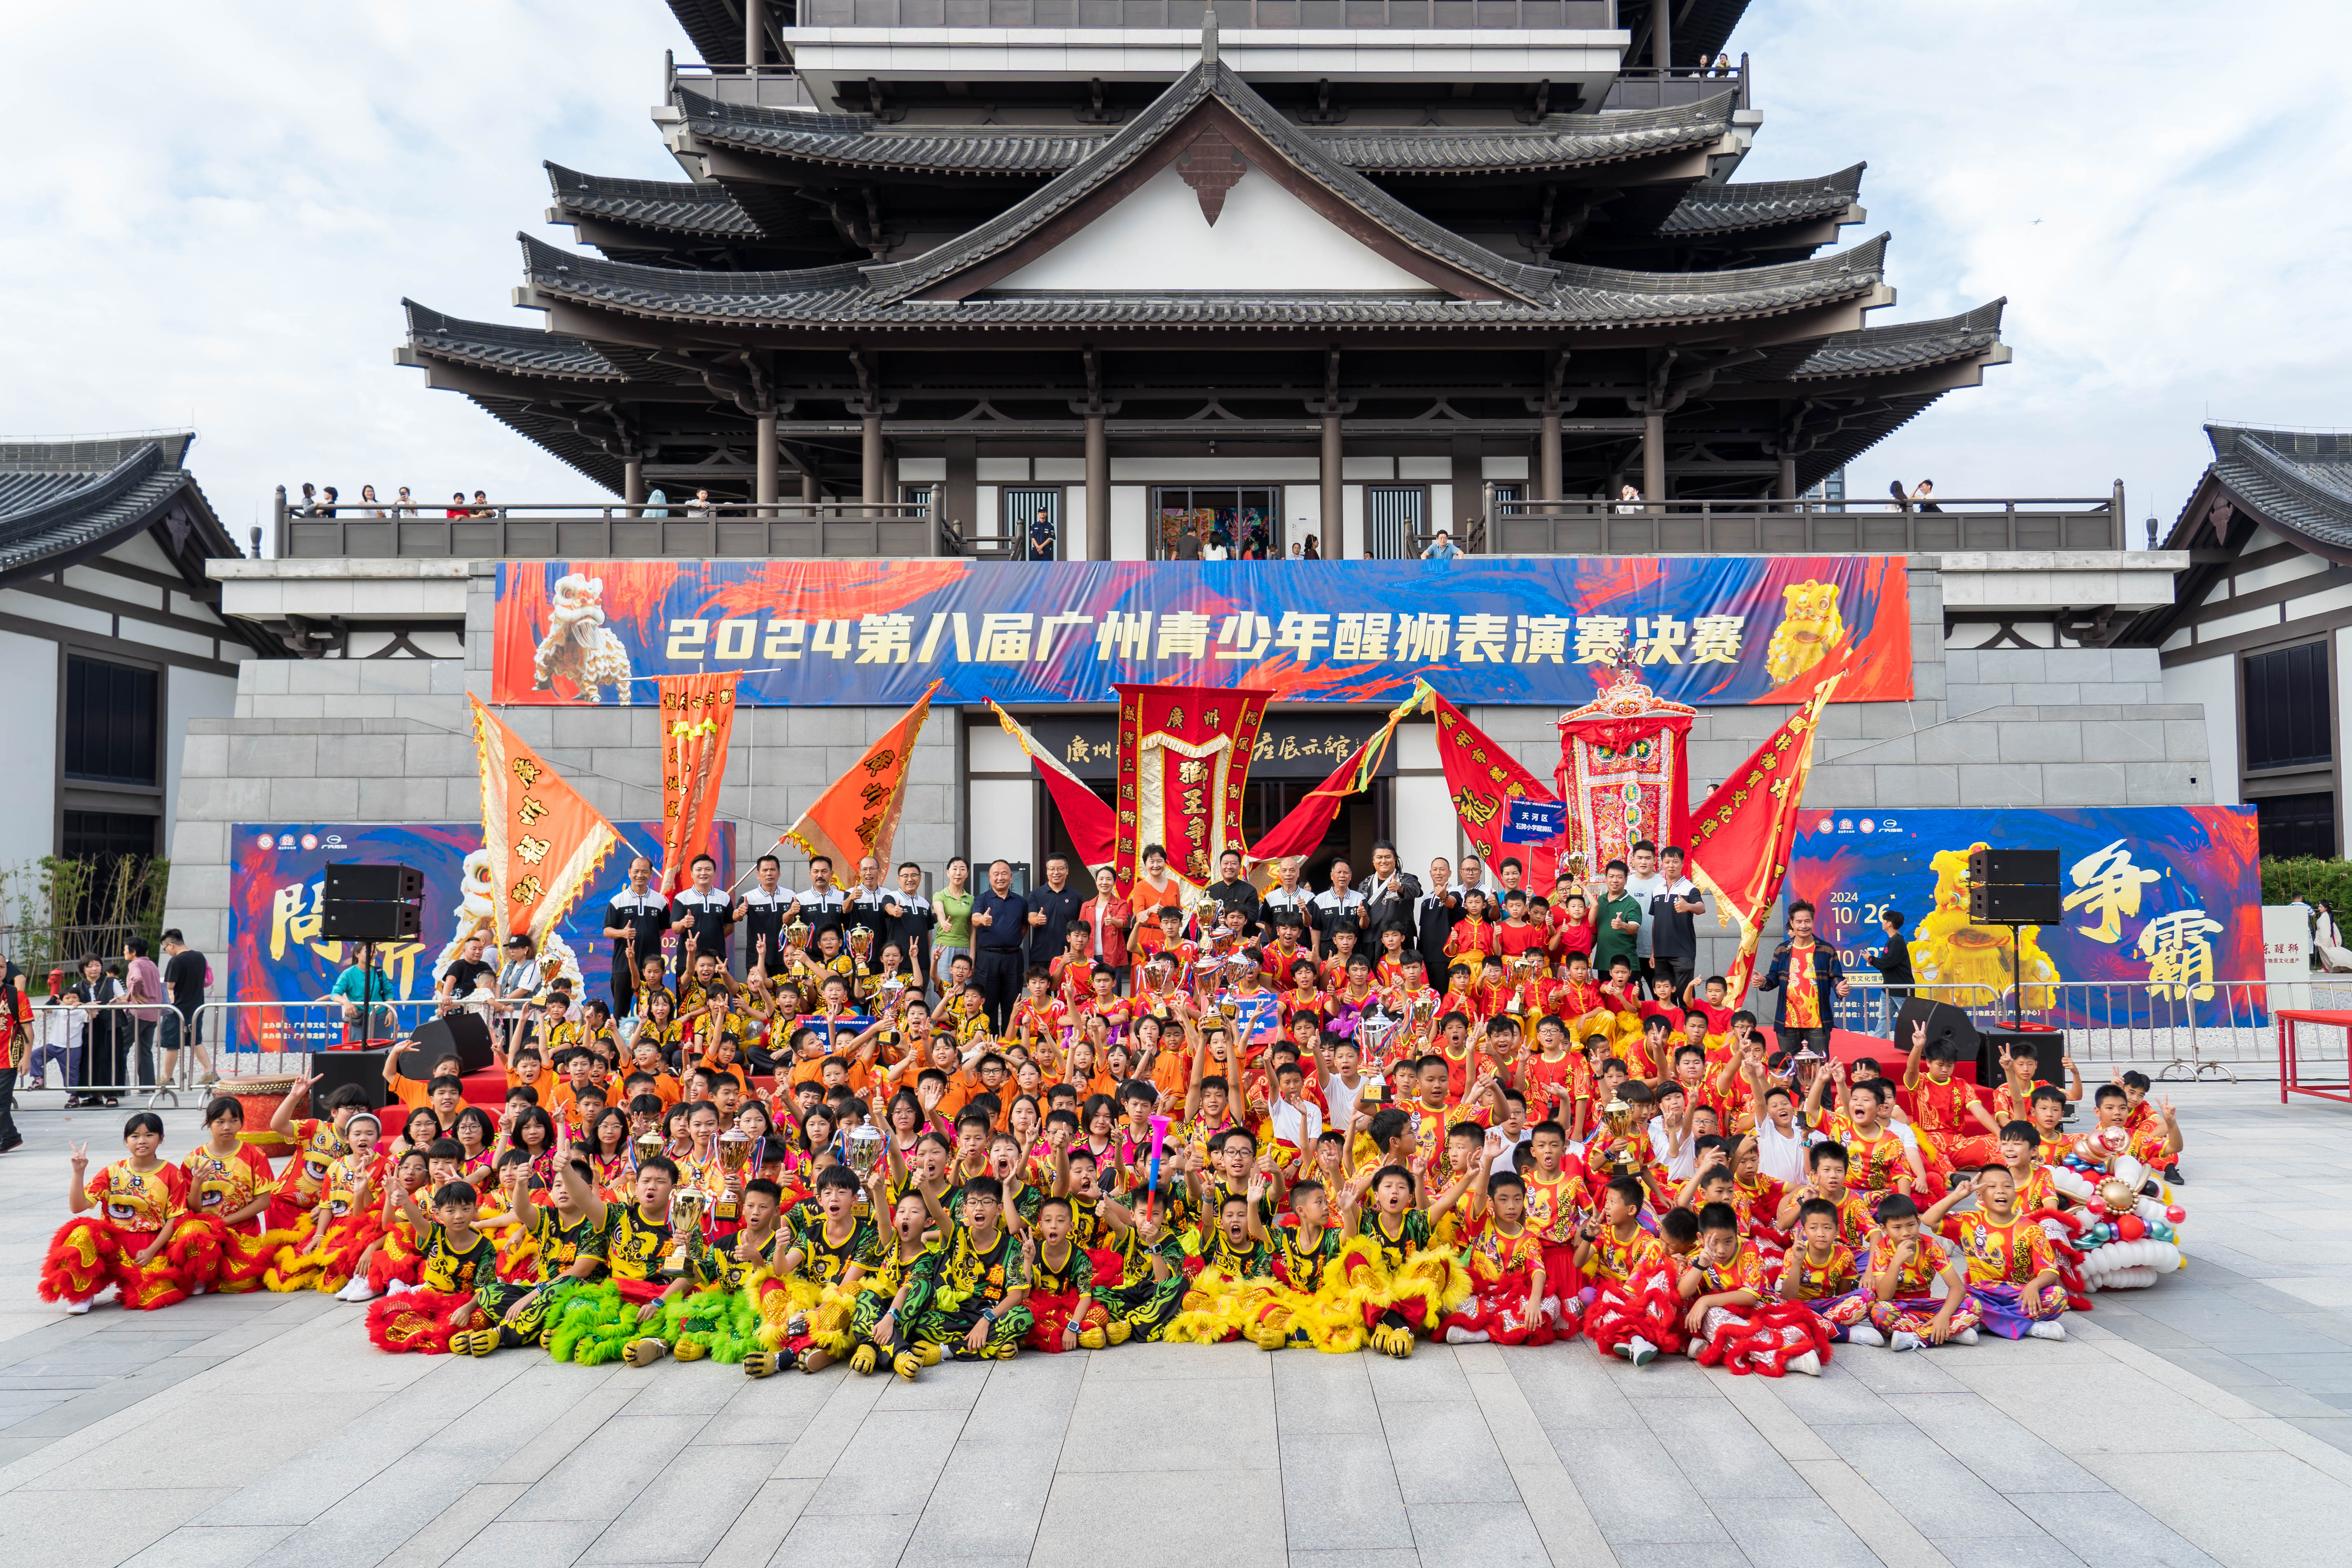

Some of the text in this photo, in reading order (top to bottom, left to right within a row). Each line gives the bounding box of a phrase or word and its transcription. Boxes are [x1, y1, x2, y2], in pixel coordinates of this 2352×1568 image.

[666, 611, 1744, 664] 2024第八届广州青少年醒狮表演赛决赛
[1166, 706, 1220, 730] 廣州
[1066, 735, 1119, 763] 廣州
[1522, 812, 1548, 822] 天河区
[1515, 823, 1552, 832] 石牌小学醒狮队
[1831, 892, 1858, 902] 2024
